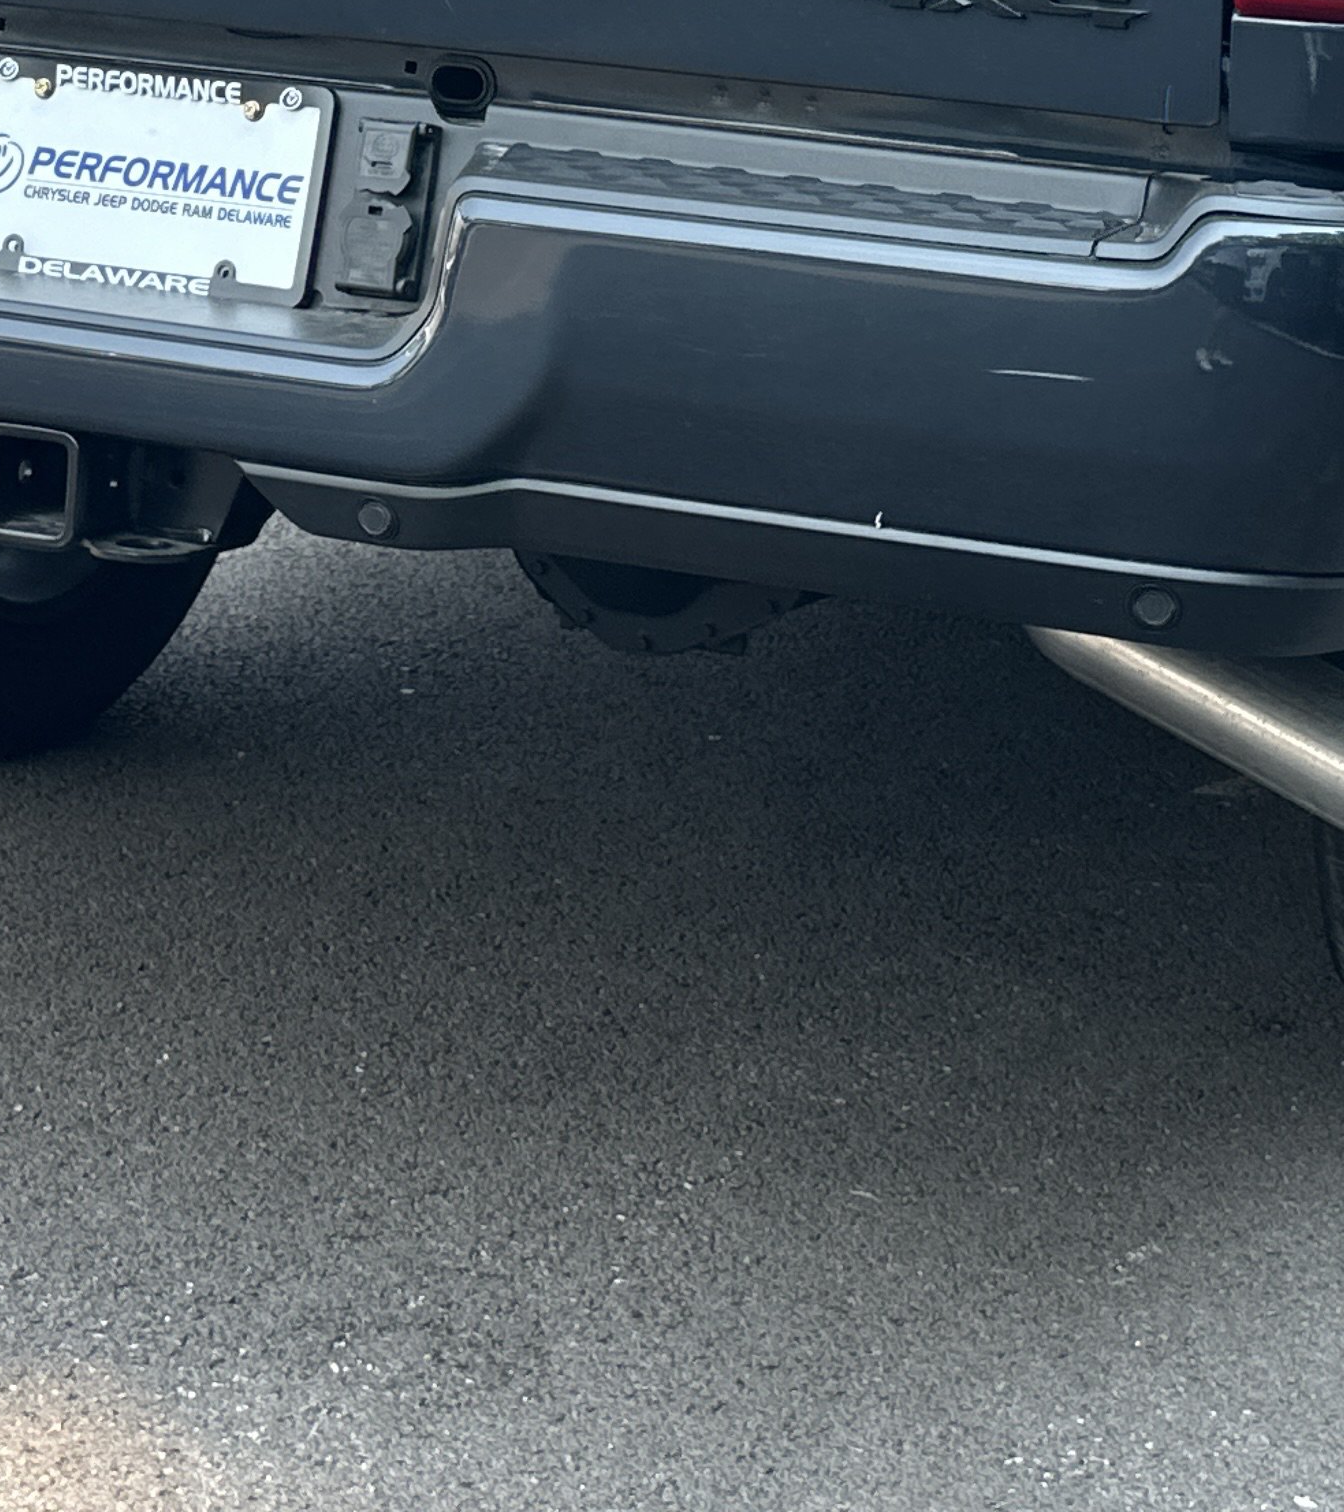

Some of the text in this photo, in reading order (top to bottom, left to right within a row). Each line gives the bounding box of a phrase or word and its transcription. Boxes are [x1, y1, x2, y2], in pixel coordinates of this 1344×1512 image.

[55, 63, 243, 105] PERFORMANCE
[27, 145, 306, 205] PERFORMANCE
[23, 184, 293, 230] CHRYSLER JEEP DODGE RAM DELAWARE
[17, 255, 212, 297] DELAWARE
